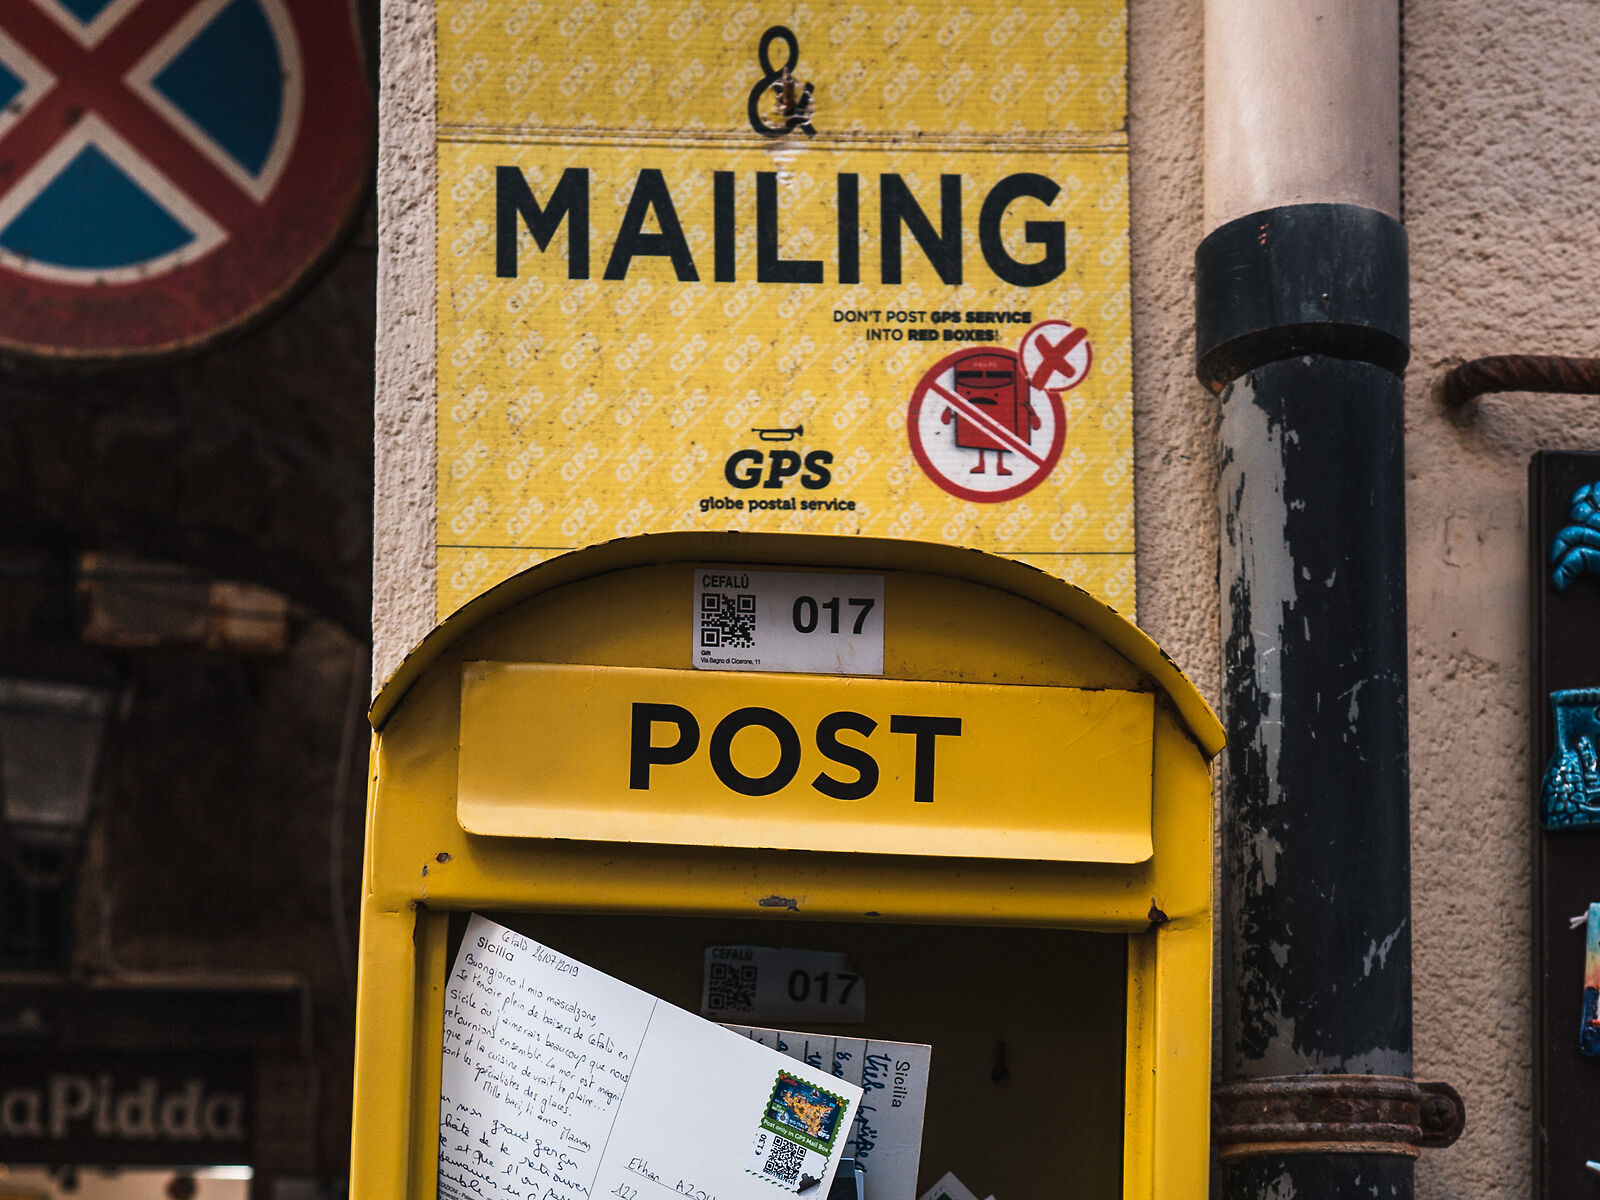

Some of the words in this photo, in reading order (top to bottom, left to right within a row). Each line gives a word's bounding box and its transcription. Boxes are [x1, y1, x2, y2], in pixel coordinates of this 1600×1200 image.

[748, 25, 817, 138] &
[495, 165, 1067, 288] MAILING
[833, 310, 882, 323] DON'T
[886, 310, 926, 323] POST
[930, 311, 962, 324] GPS
[965, 311, 1032, 324] SERVICE
[866, 329, 904, 341] INTO
[908, 330, 939, 342] RED
[724, 449, 834, 490] GPS
[699, 496, 744, 512] globe
[749, 497, 796, 512] postal
[800, 498, 856, 511] service
[702, 573, 750, 589] CEFALÙ
[791, 596, 875, 635] 017
[629, 702, 962, 803] POST
[477, 936, 514, 962] Sicilia
[465, 953, 516, 985] Buongiorno
[788, 969, 859, 1005] 017
[891, 1060, 911, 1109] Sicilia
